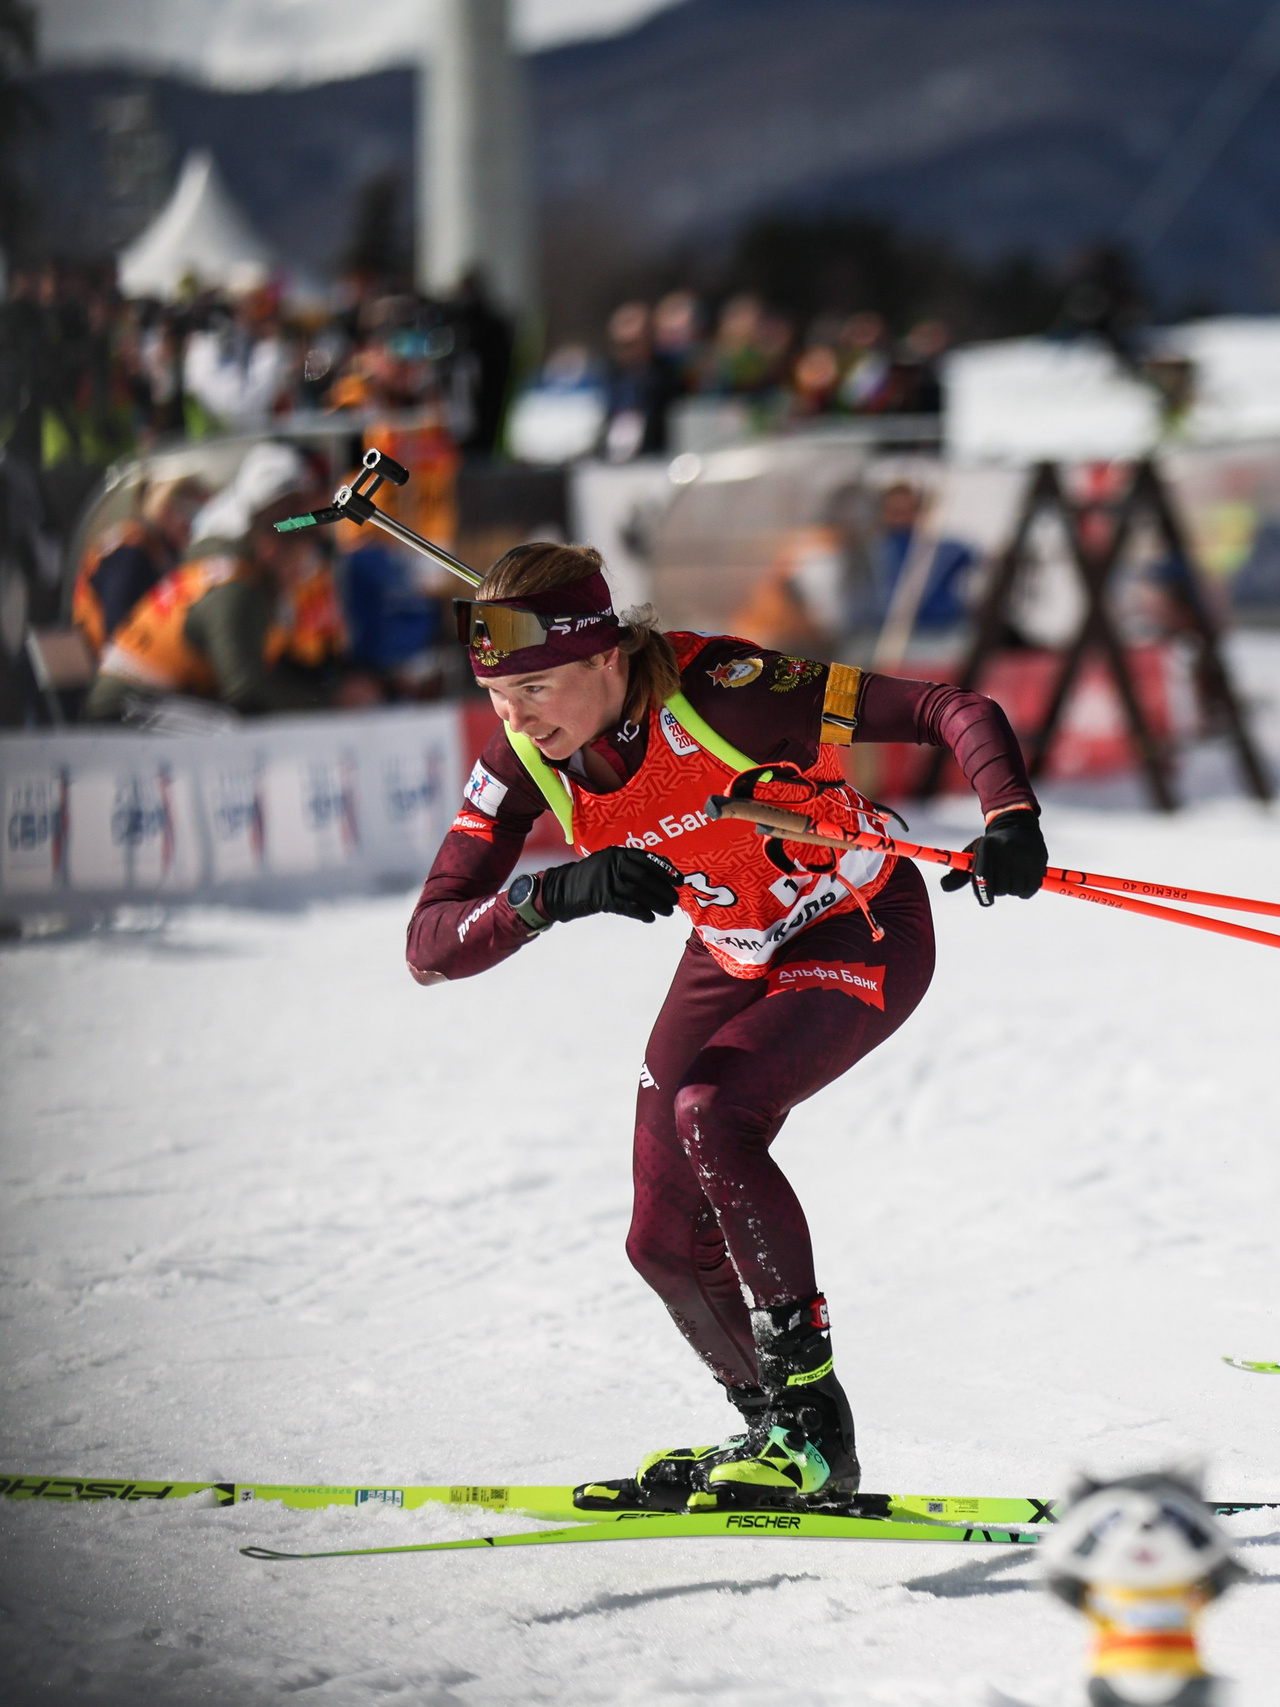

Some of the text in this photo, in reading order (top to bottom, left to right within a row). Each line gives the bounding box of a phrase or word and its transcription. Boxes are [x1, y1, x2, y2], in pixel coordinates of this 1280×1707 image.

[658, 809, 717, 839] Бан
[783, 878, 799, 893] 1
[1121, 881, 1189, 900] PREMIO 40
[1058, 887, 1123, 909] PREMIO 40
[779, 966, 878, 991] Альфа Банк
[726, 1515, 801, 1529] FISCHER
